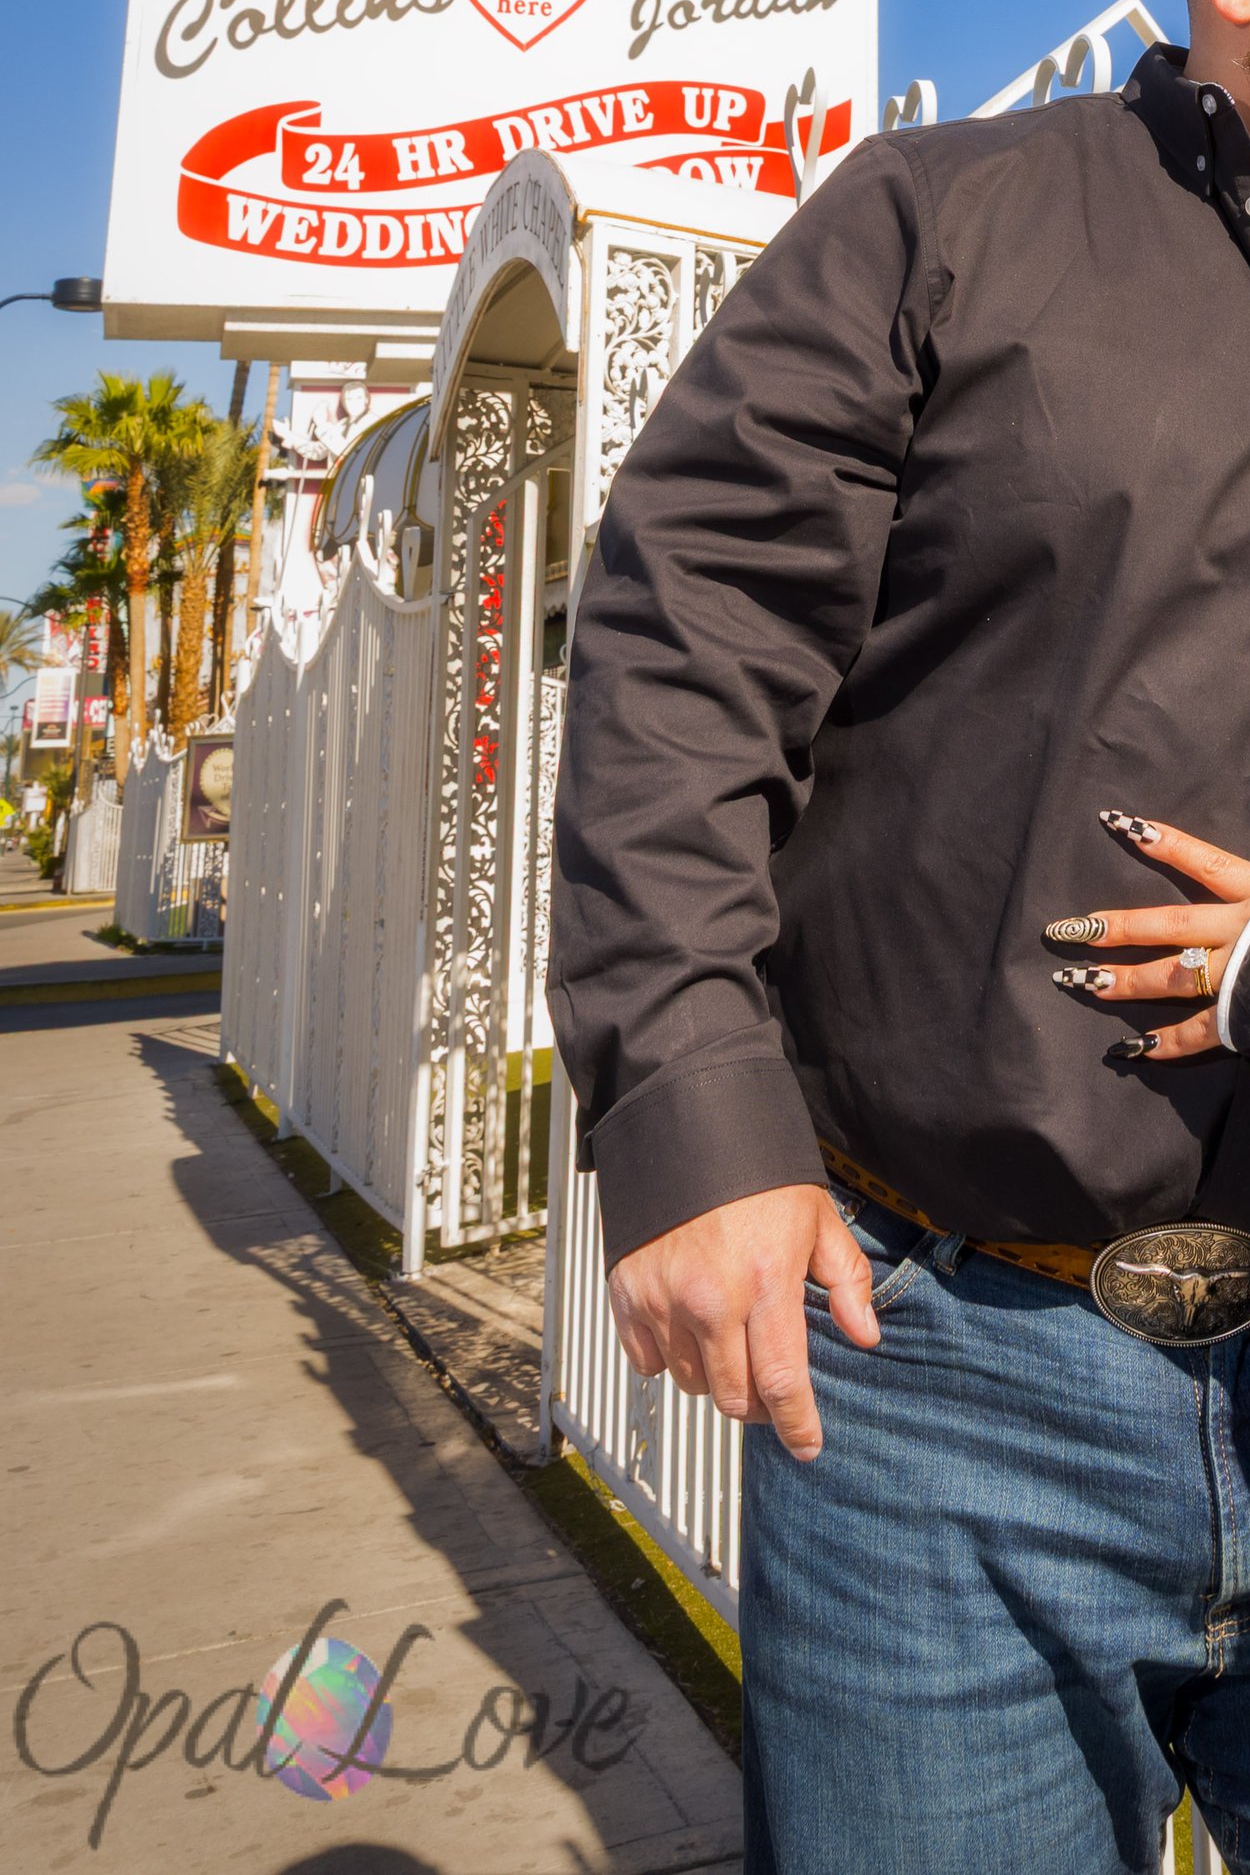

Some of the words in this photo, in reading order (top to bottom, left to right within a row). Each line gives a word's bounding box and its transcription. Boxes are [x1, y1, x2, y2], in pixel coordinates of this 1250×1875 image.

[302, 142, 366, 191] 24
[392, 129, 474, 182] HR
[492, 89, 654, 162] DRIVE
[681, 86, 747, 131] UP
[479, 181, 520, 263] WHITE
[523, 173, 567, 289] CHAPEL
